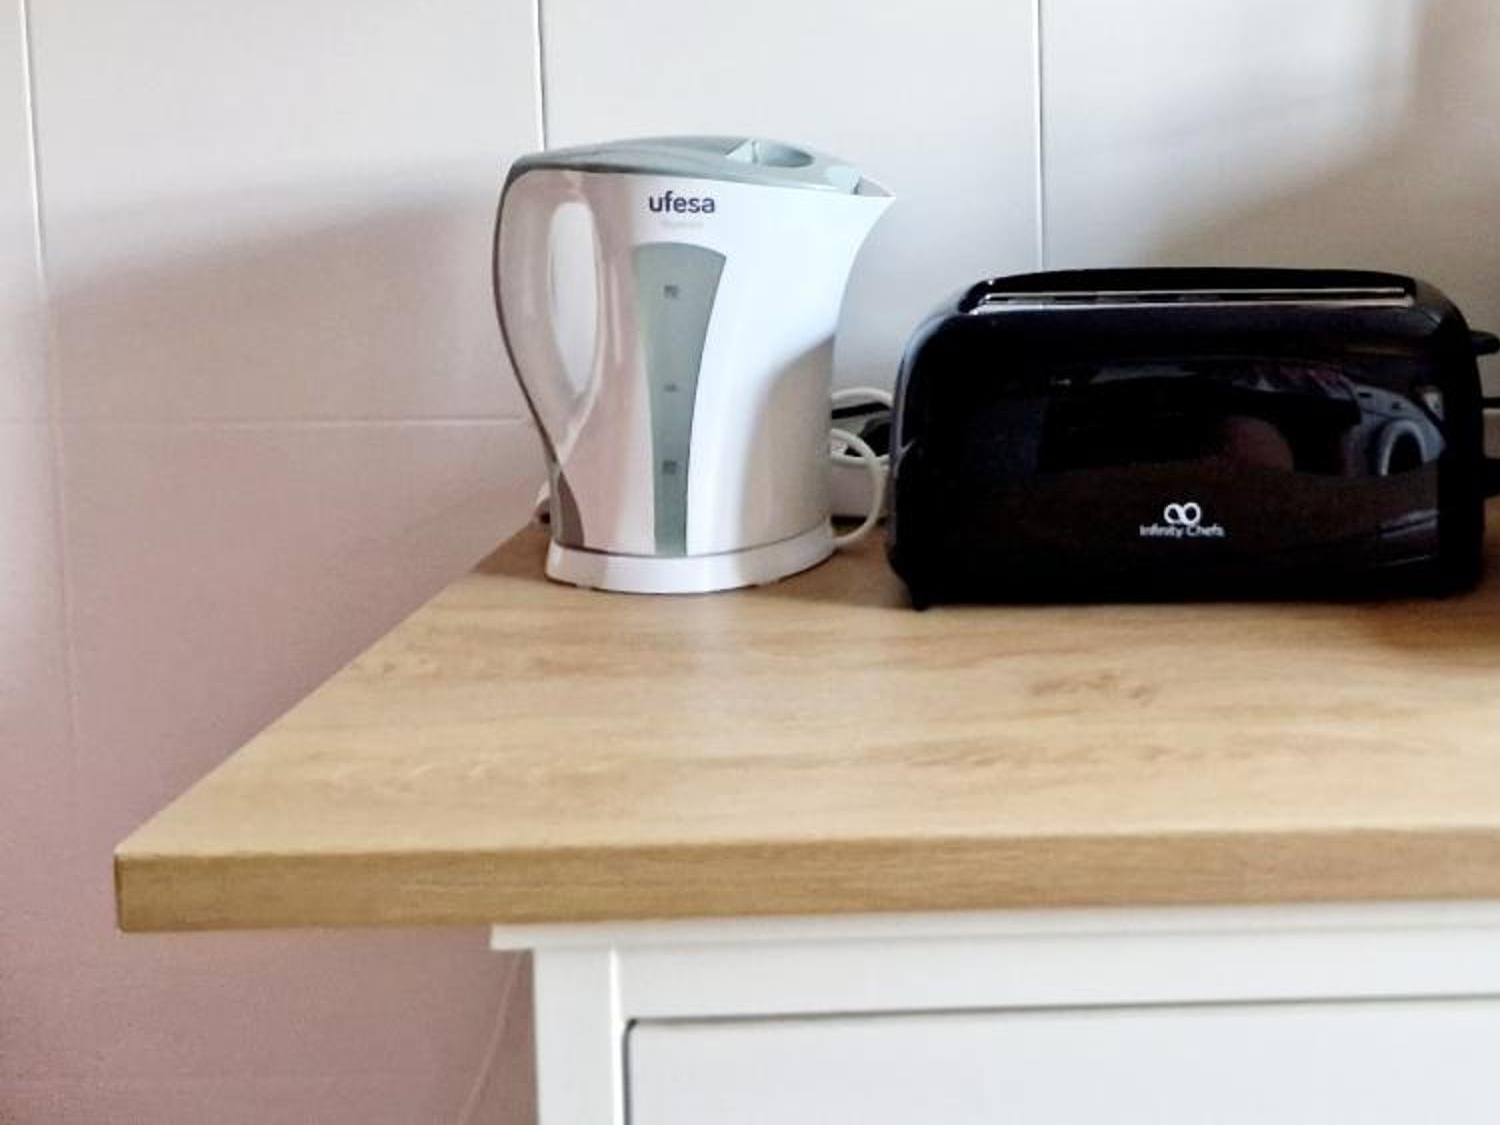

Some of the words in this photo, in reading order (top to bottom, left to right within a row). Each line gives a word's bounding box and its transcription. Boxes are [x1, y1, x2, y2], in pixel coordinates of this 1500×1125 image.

[649, 190, 715, 213] ufesa
[1139, 523, 1183, 538] Infinity
[1187, 522, 1225, 537] Chefs
